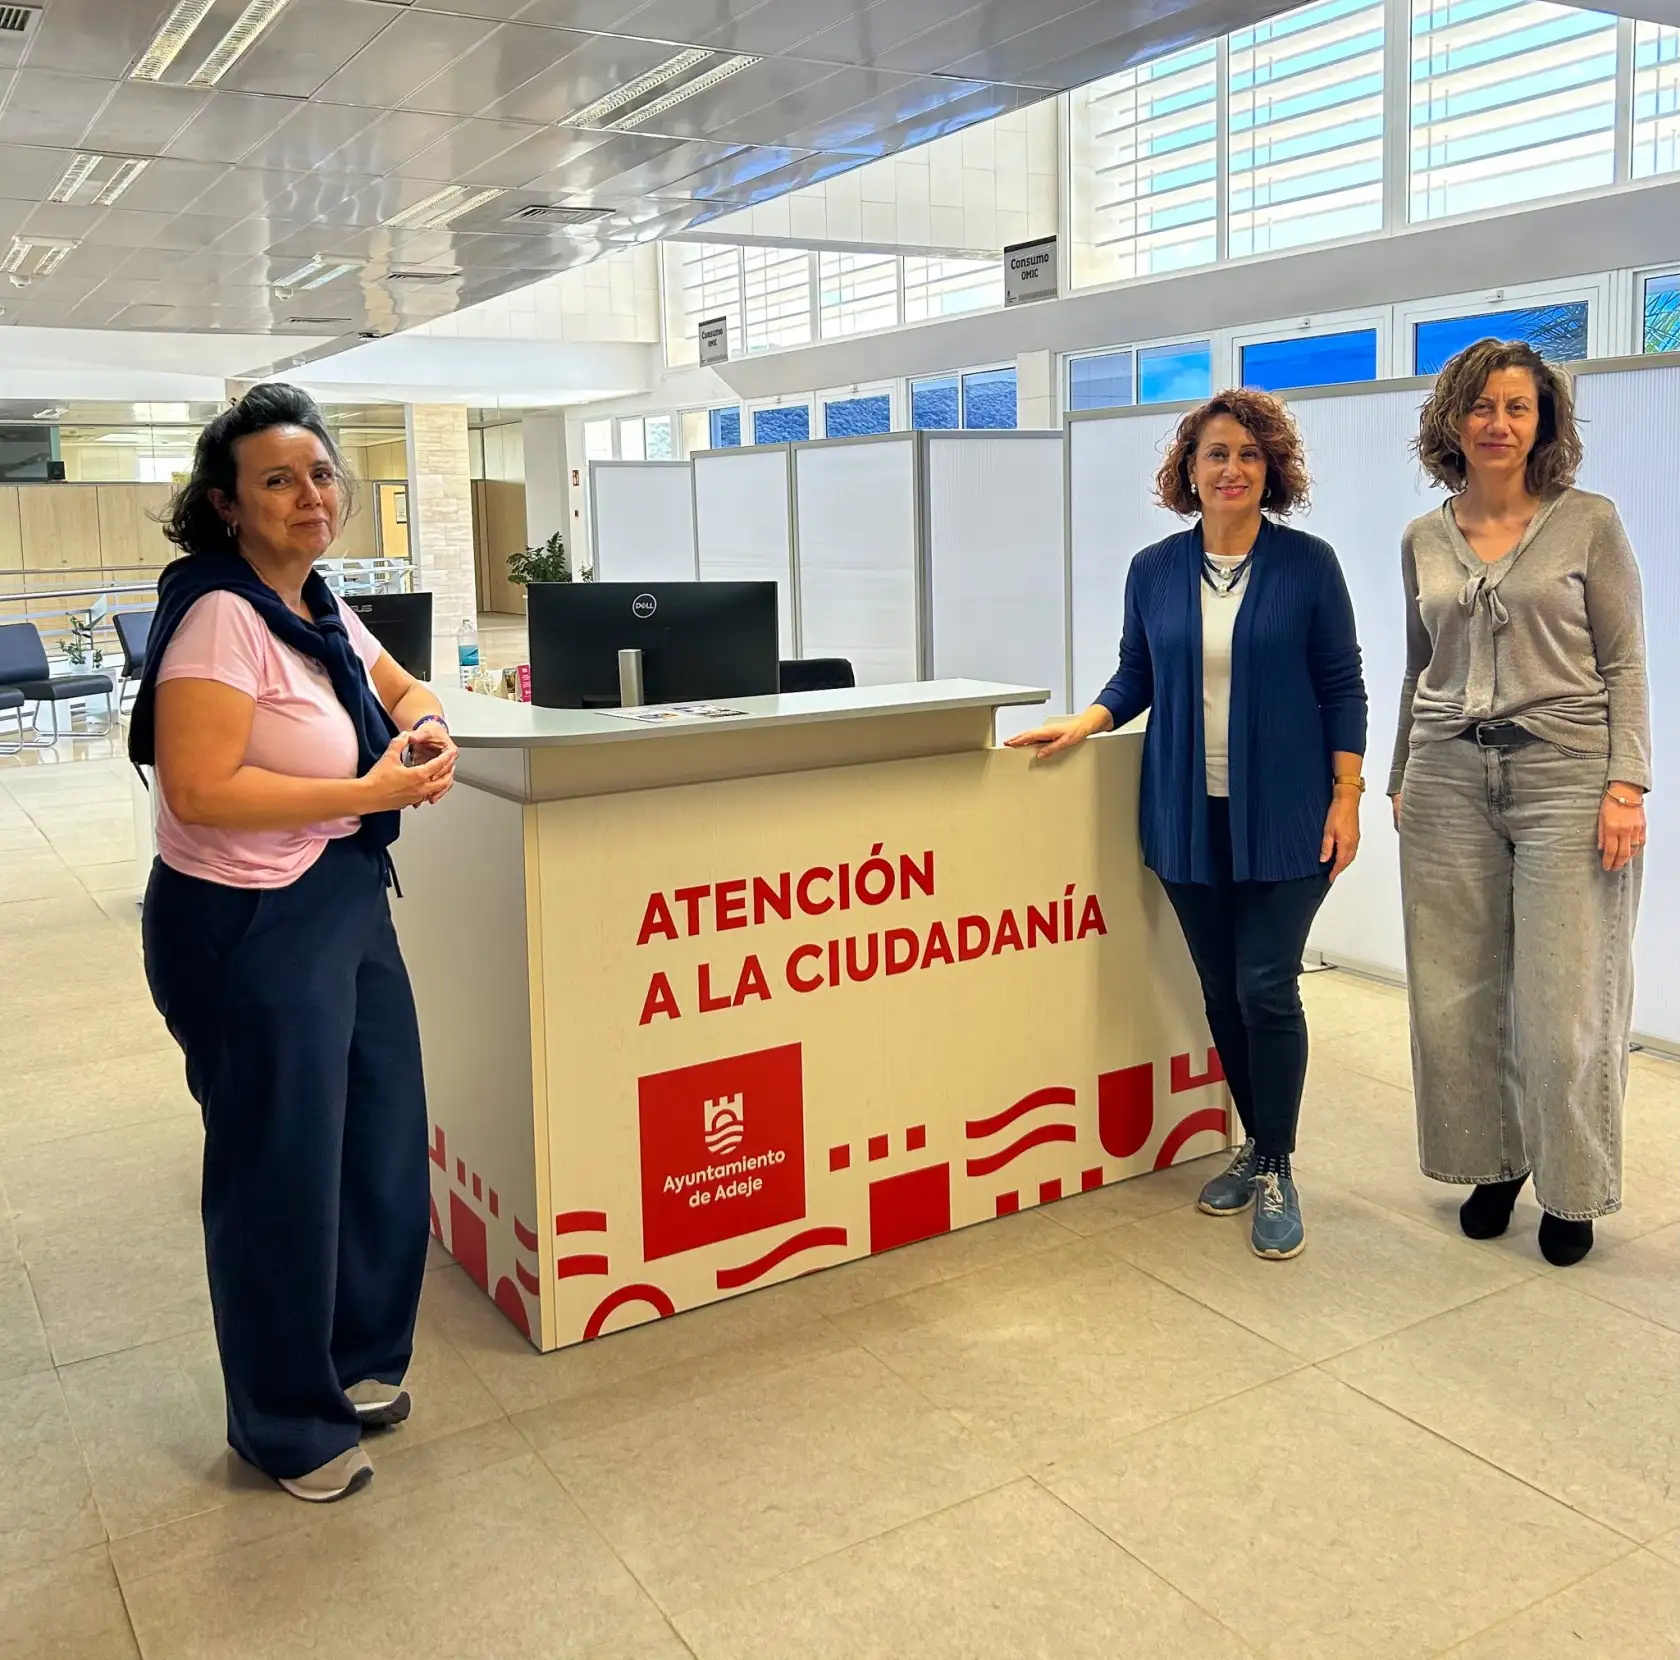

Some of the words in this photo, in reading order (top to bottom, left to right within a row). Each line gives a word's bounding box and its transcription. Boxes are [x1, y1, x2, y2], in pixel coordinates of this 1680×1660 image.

[1010, 253, 1049, 269] Consumo
[1021, 268, 1038, 280] OMIC
[702, 328, 723, 340] Consumo
[350, 604, 373, 613] SUS
[636, 842, 934, 946] ATENCIÓN
[639, 971, 682, 1026] A
[697, 954, 772, 1013] LA
[785, 883, 1109, 993] CIUDADANÍA
[663, 1150, 786, 1193] Ayuntamiento
[688, 1190, 711, 1208] de
[714, 1176, 763, 1201] Adeje
